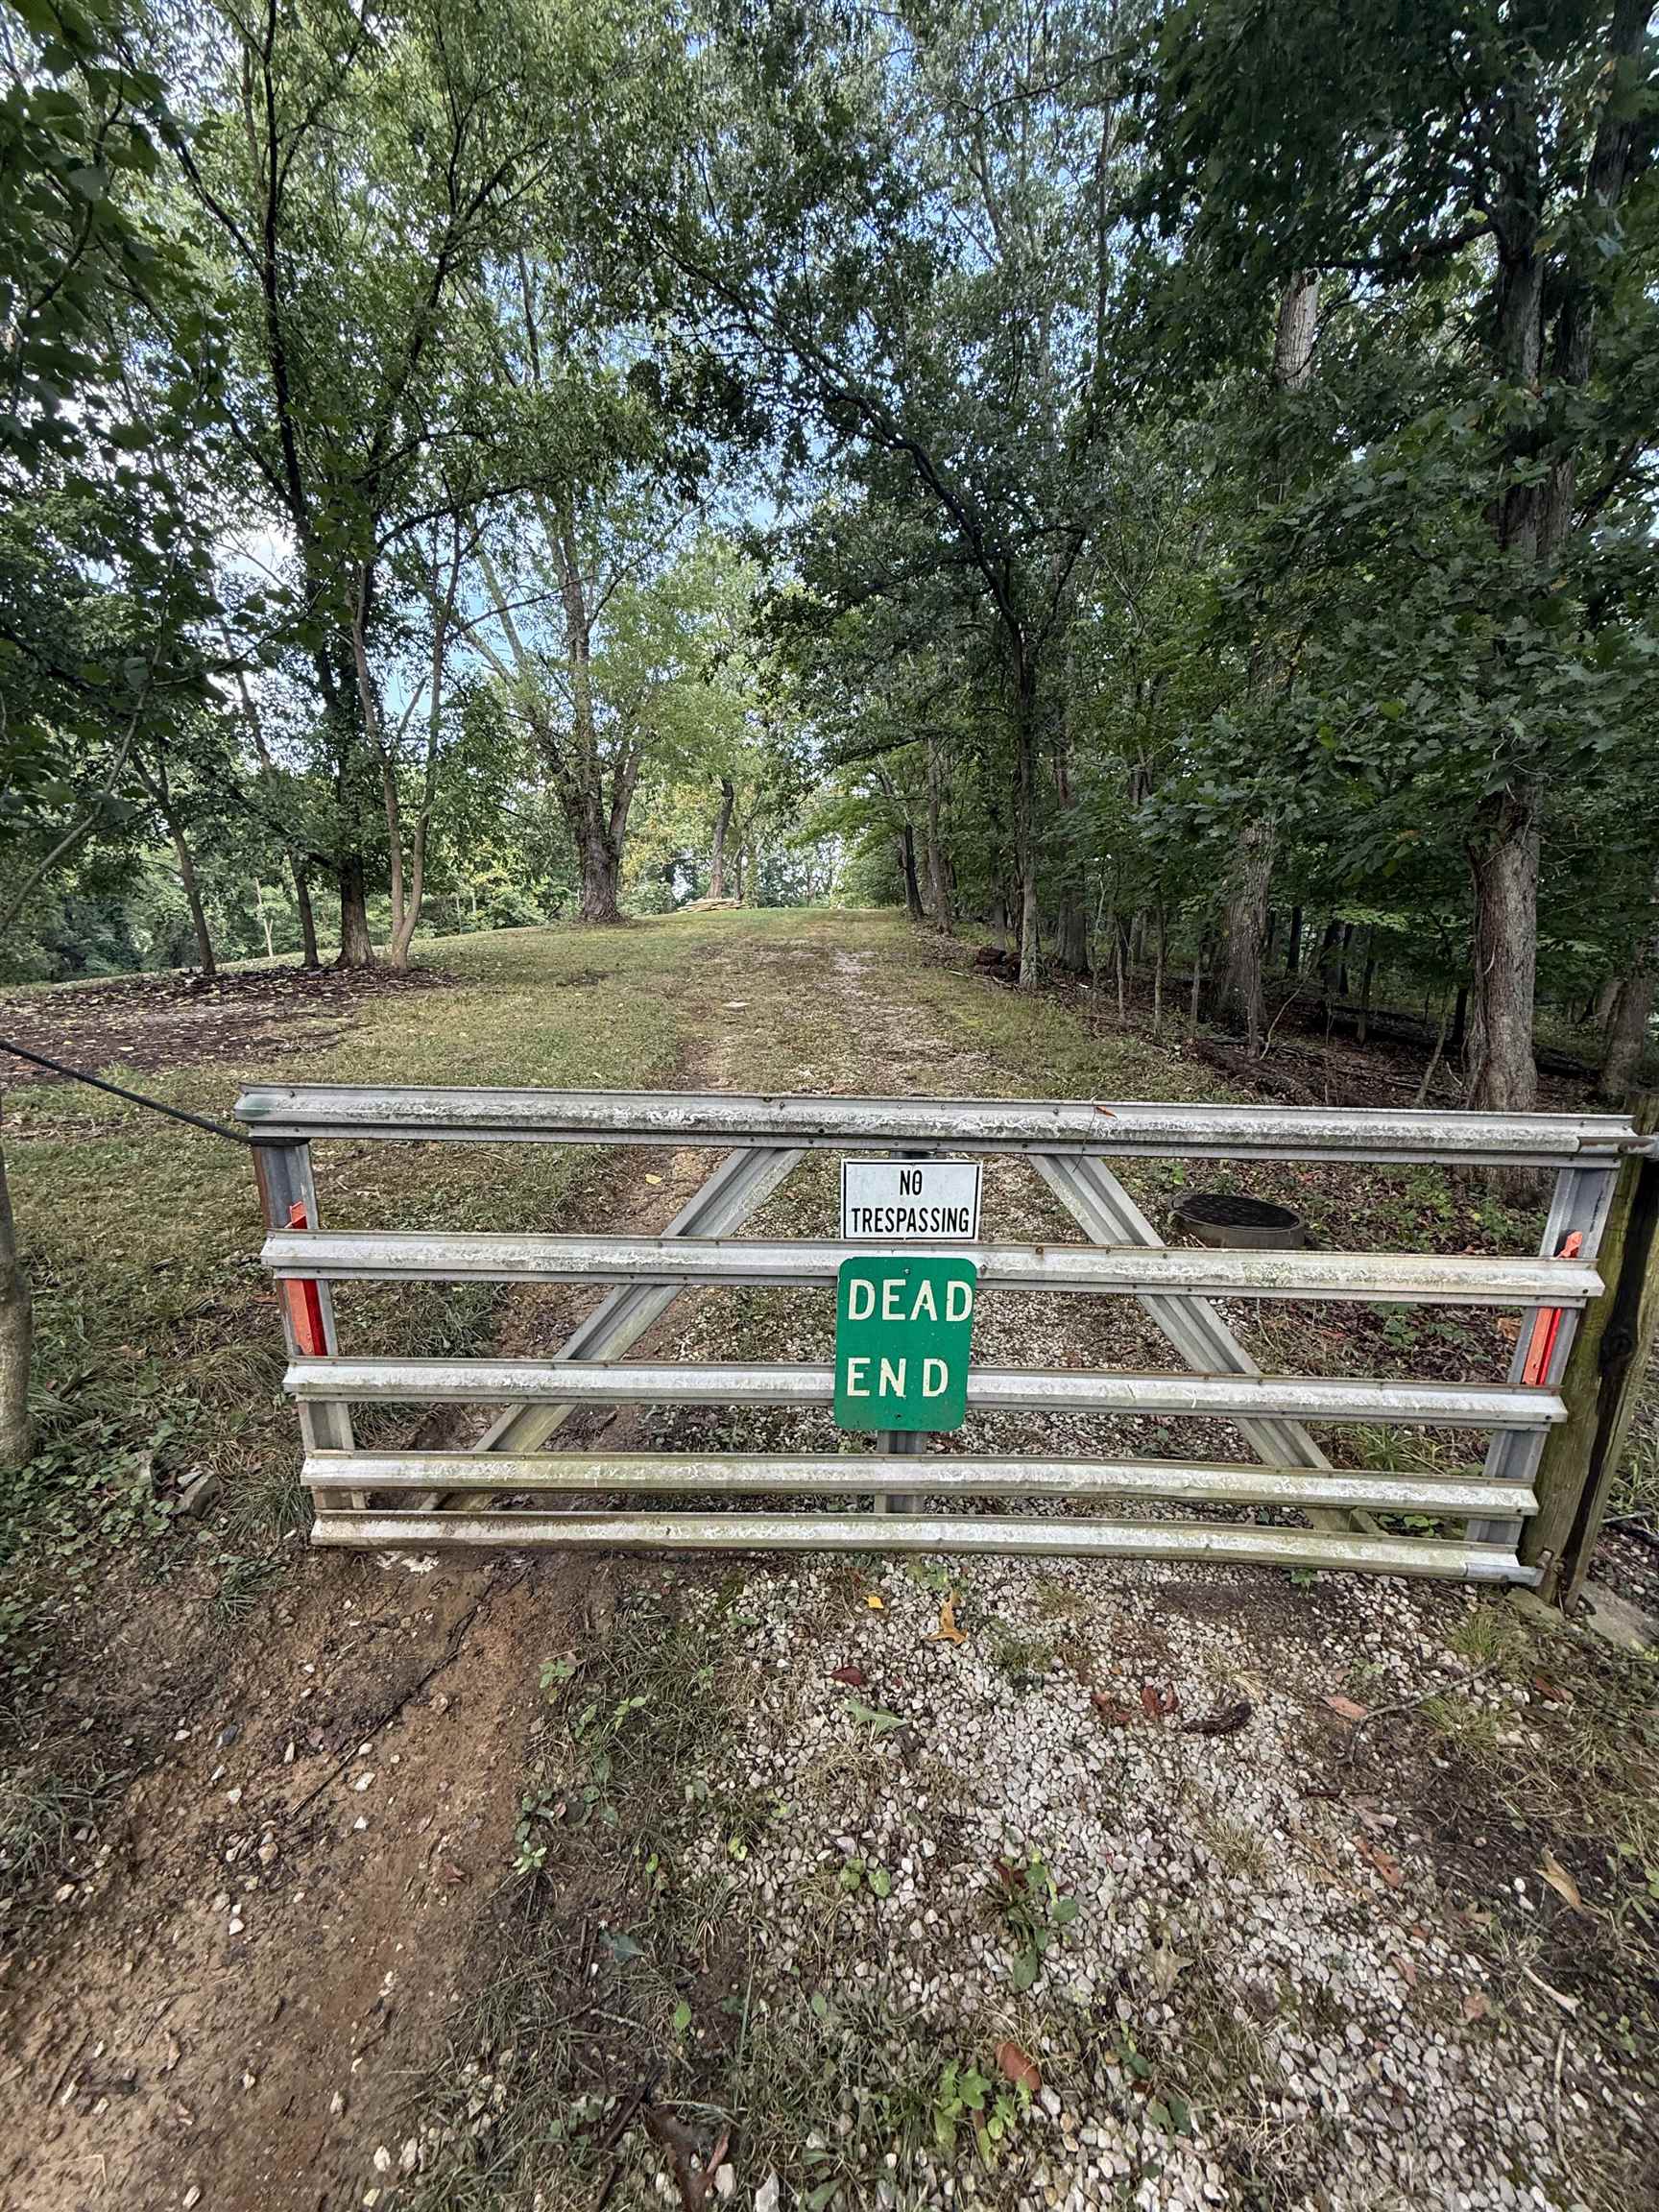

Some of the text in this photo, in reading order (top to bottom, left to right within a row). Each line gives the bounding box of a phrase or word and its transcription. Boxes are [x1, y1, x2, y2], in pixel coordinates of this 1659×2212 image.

[900, 1169, 923, 1195] NO
[852, 1207, 970, 1233] TRESPASSING
[848, 1279, 973, 1322] DEAD
[846, 1357, 950, 1398] END
